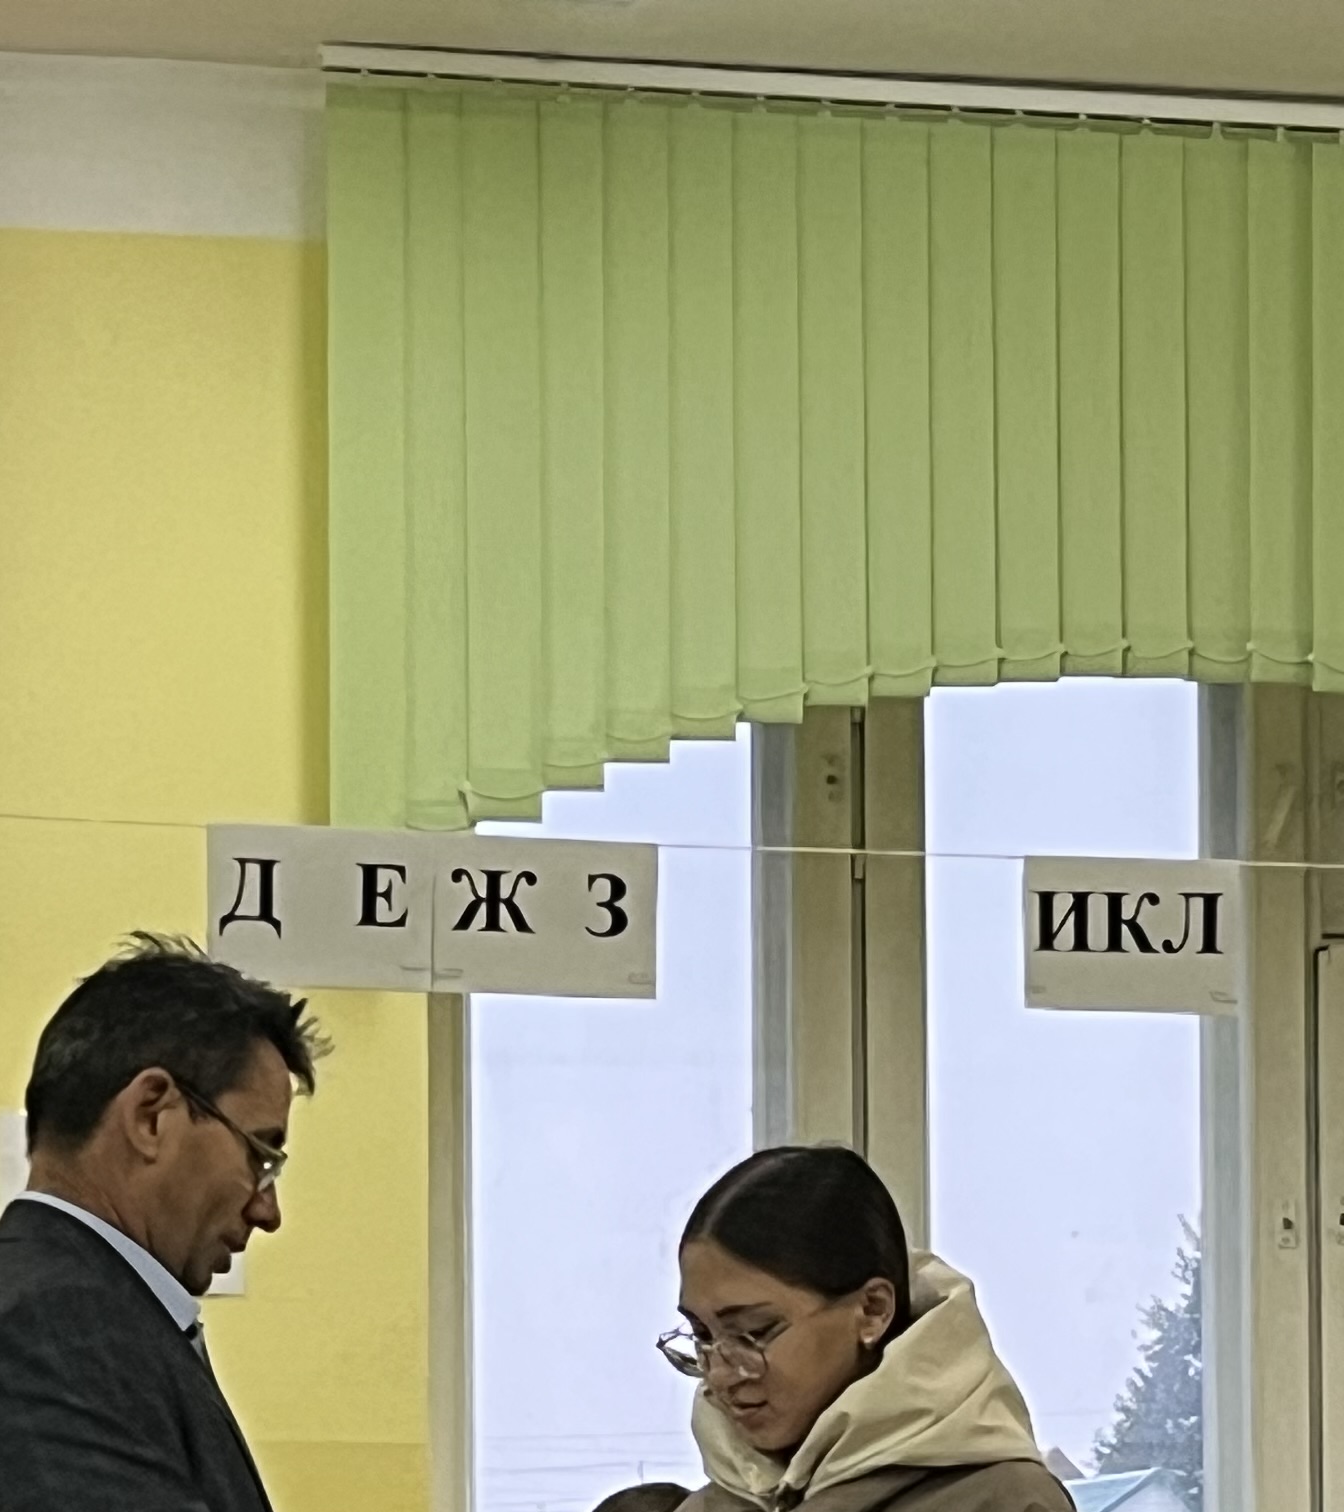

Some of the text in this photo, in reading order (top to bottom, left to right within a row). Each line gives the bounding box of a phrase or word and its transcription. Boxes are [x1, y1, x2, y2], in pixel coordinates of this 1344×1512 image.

[218, 857, 630, 939] Д Е Ж З
[1033, 890, 1224, 955] ИКЛ
